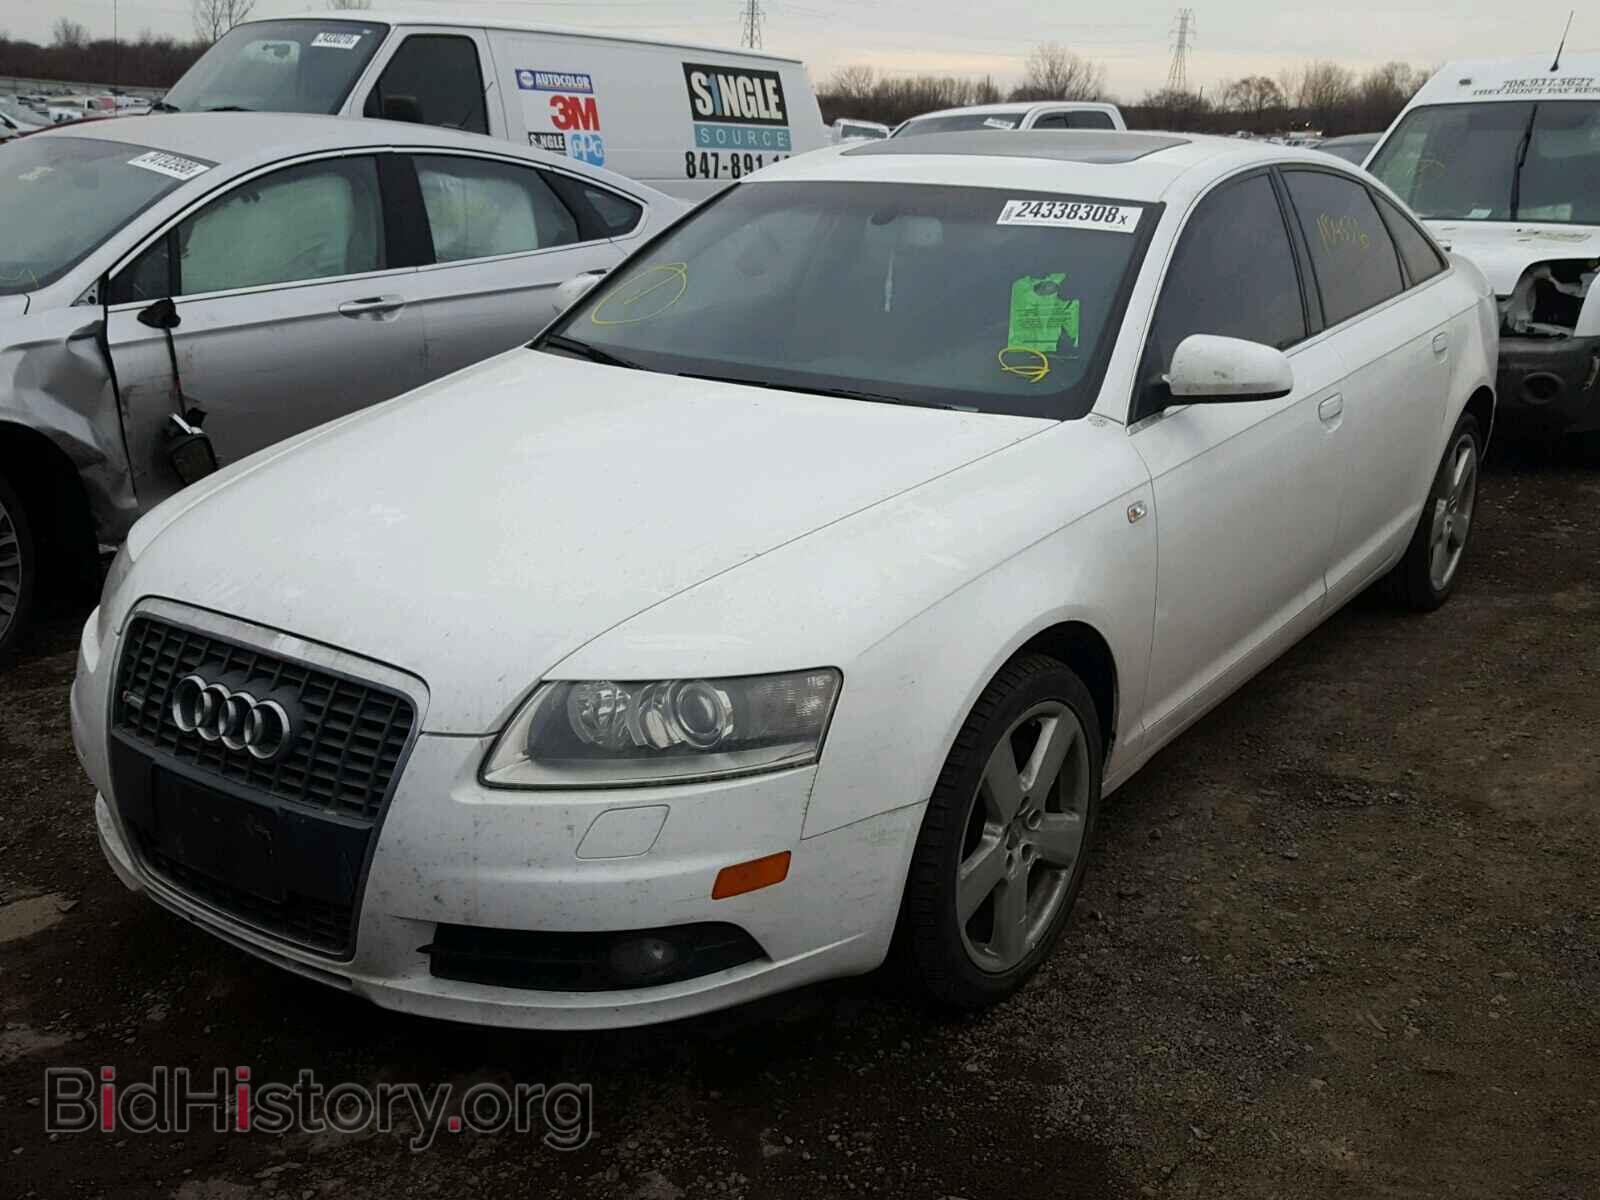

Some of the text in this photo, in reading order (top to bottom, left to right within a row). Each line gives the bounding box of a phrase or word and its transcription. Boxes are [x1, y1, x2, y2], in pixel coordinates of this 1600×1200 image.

[535, 72, 591, 89] AUTOCOLOR
[550, 95, 600, 131] 3M
[700, 127, 785, 147] SOURCE
[685, 151, 790, 179] 847-891
